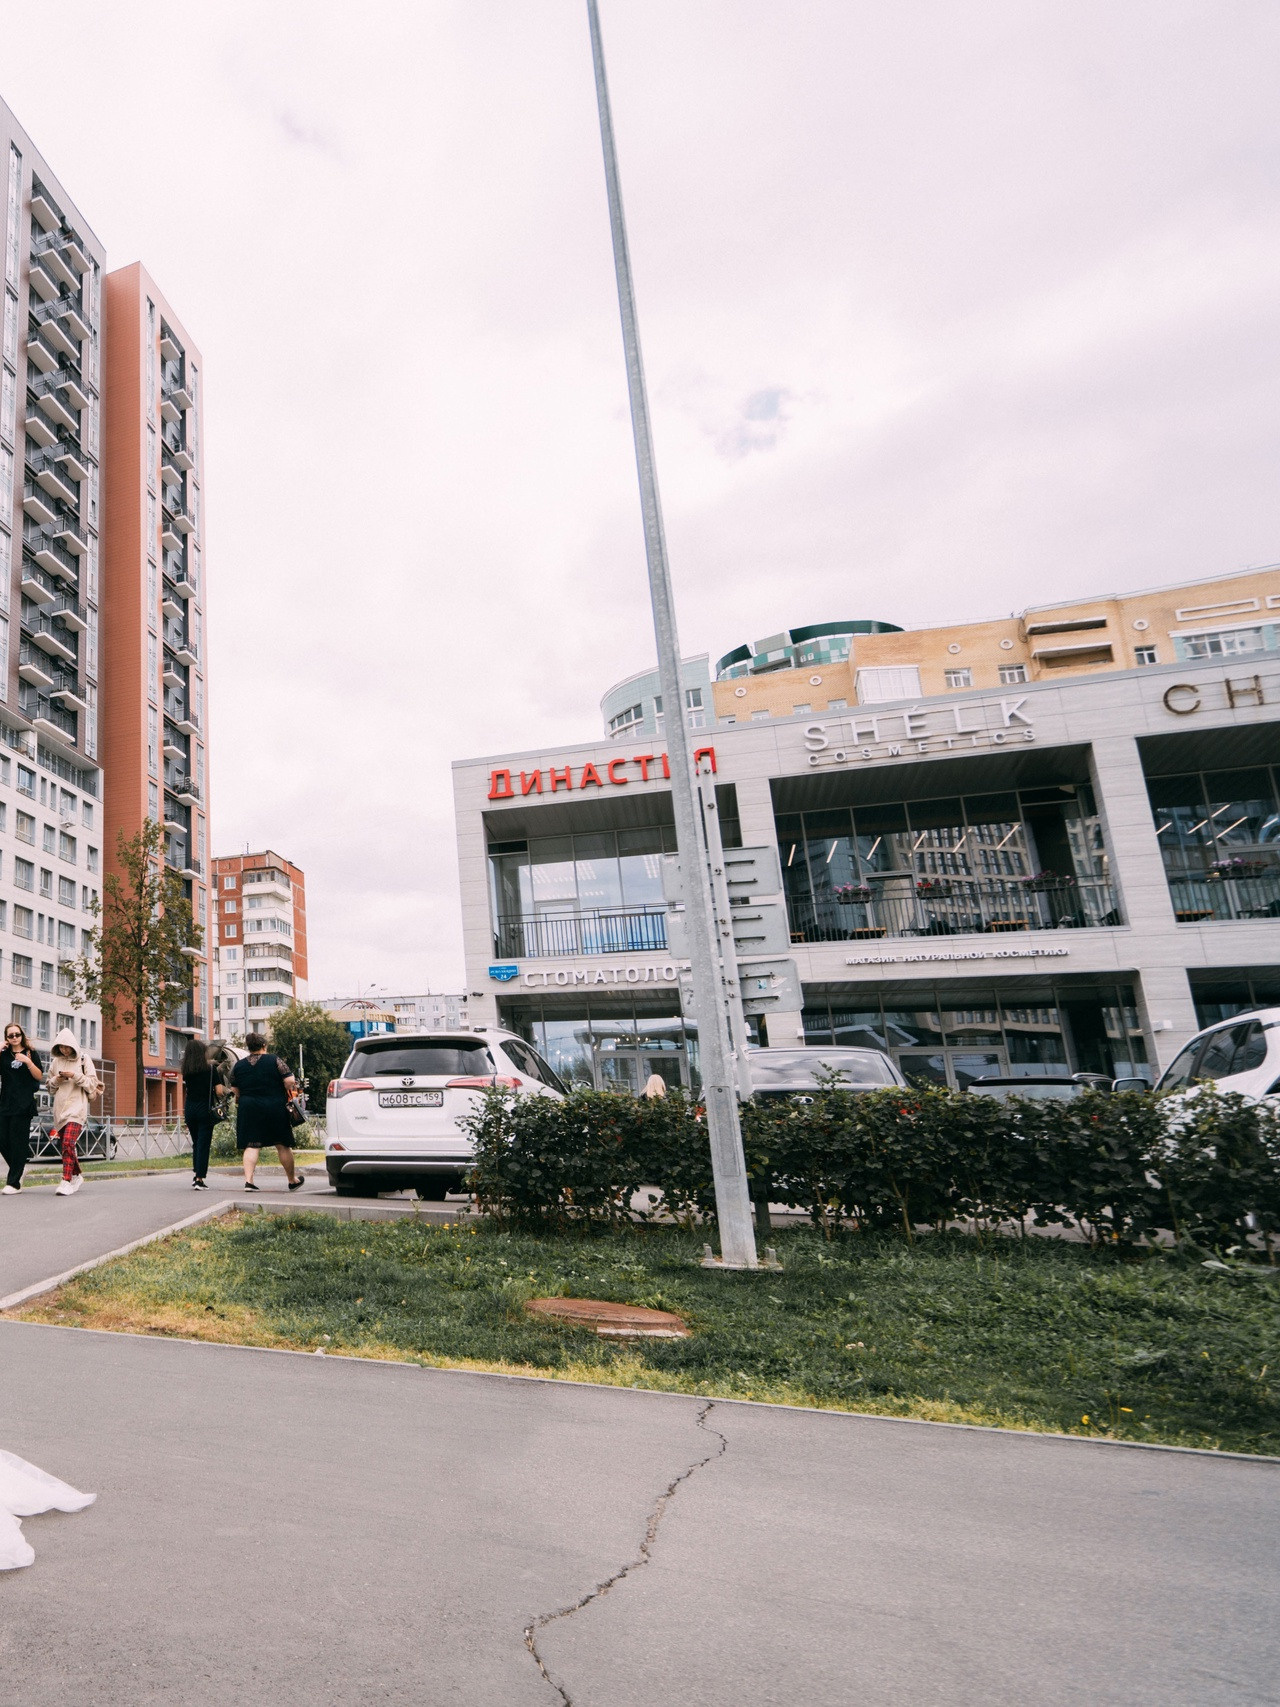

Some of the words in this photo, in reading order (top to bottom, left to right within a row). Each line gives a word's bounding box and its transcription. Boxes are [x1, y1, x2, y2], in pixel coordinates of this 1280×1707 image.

[808, 729, 1036, 766] COSMETICS
[845, 956, 897, 965] МАГАЗИН
[904, 951, 986, 962] НАТУРАЛЬНОЙ
[993, 948, 1071, 958] КОСМЕТИКИ
[523, 965, 691, 987] СТОМАТОЛО
[424, 1093, 439, 1101] 159
